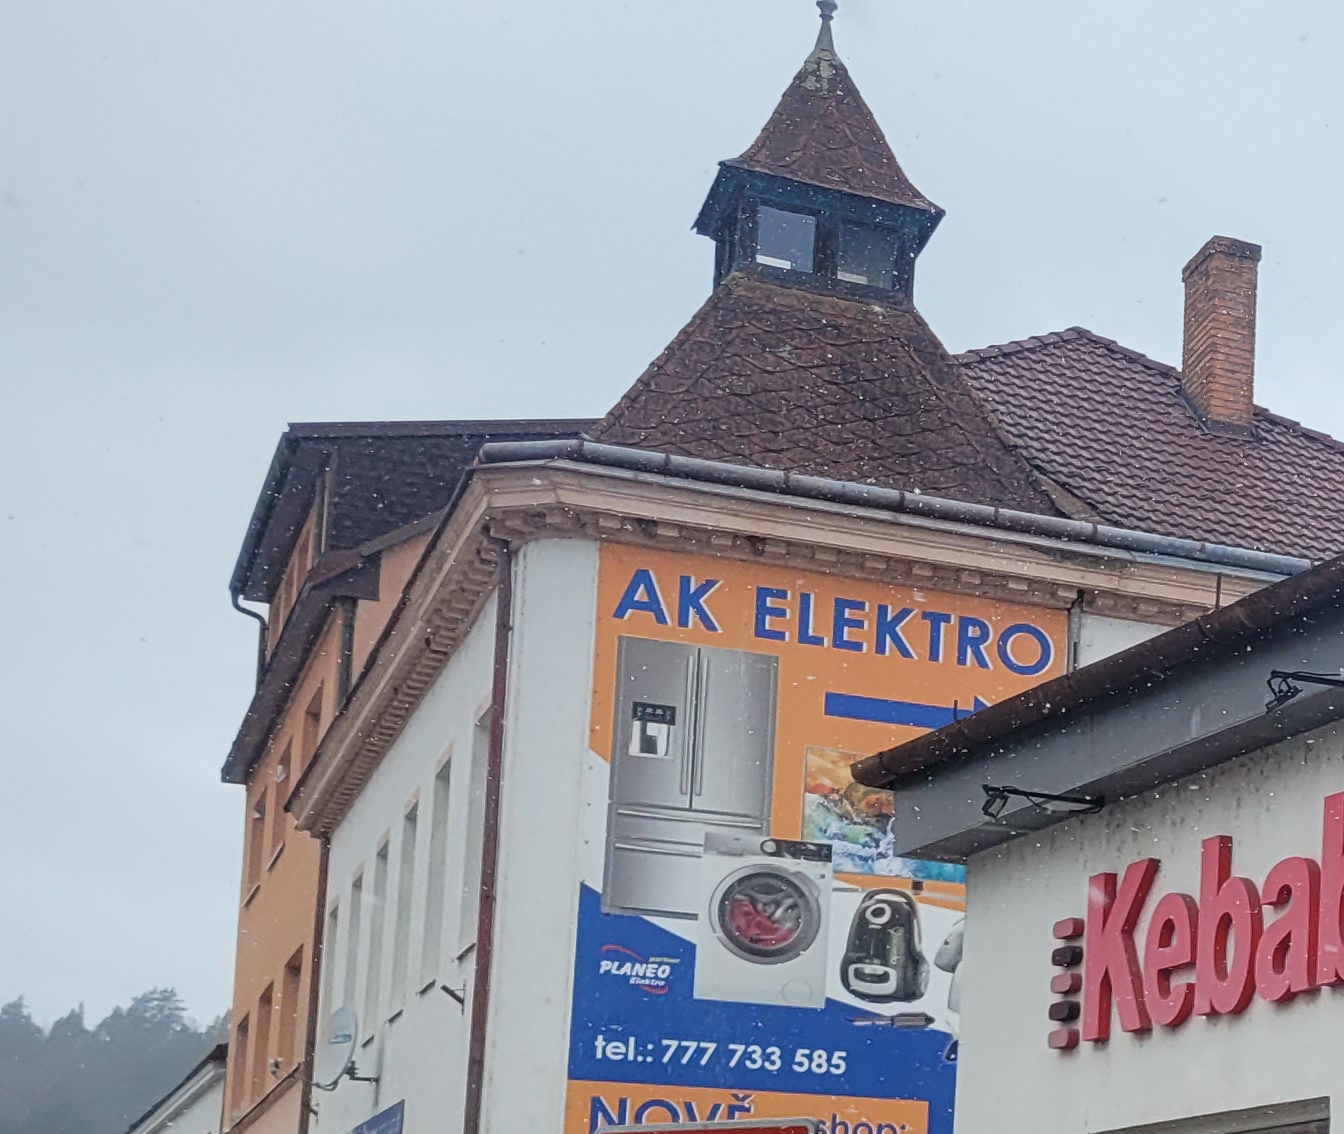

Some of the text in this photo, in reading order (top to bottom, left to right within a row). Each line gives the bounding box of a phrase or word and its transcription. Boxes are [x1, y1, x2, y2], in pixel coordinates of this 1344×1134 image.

[612, 568, 1054, 676] AK ELEKTRO
[599, 960, 671, 979] PLANEO
[661, 1039, 717, 1066] 777
[728, 1043, 782, 1071] 733
[792, 1049, 847, 1075] 585
